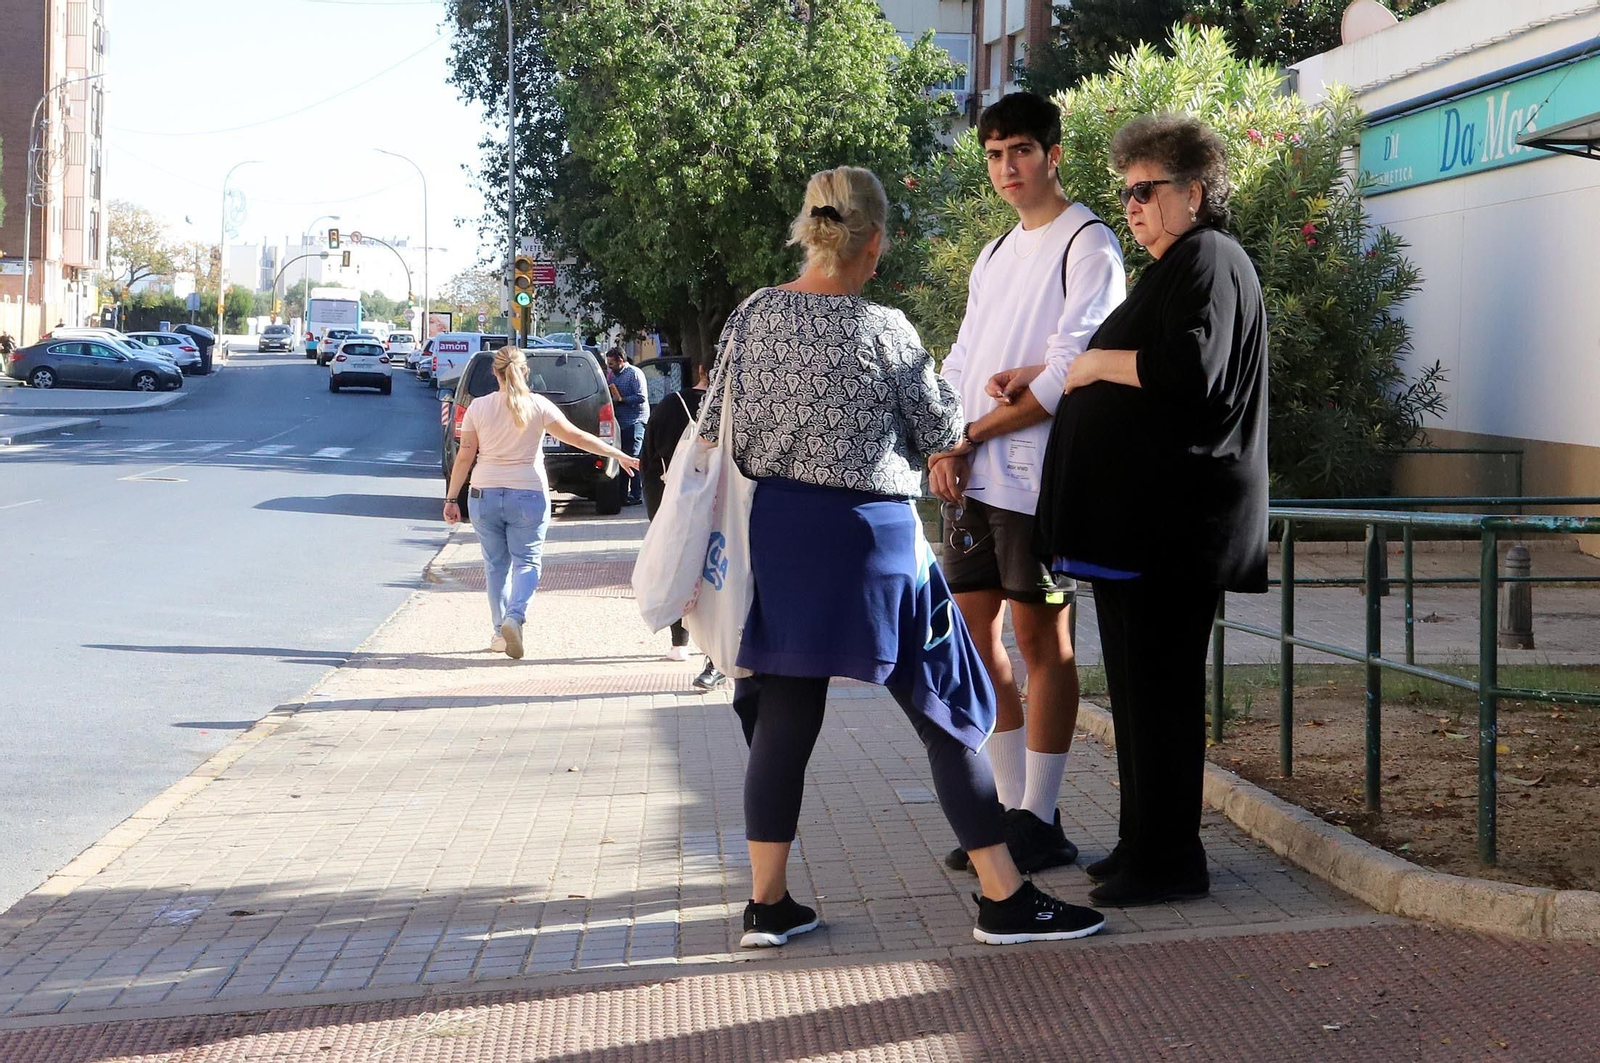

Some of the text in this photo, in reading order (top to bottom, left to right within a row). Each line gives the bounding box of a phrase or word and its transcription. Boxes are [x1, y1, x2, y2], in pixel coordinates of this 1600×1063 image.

[1384, 133, 1399, 161] DM
[1440, 108, 1475, 172] Da
[440, 341, 467, 351] amón
